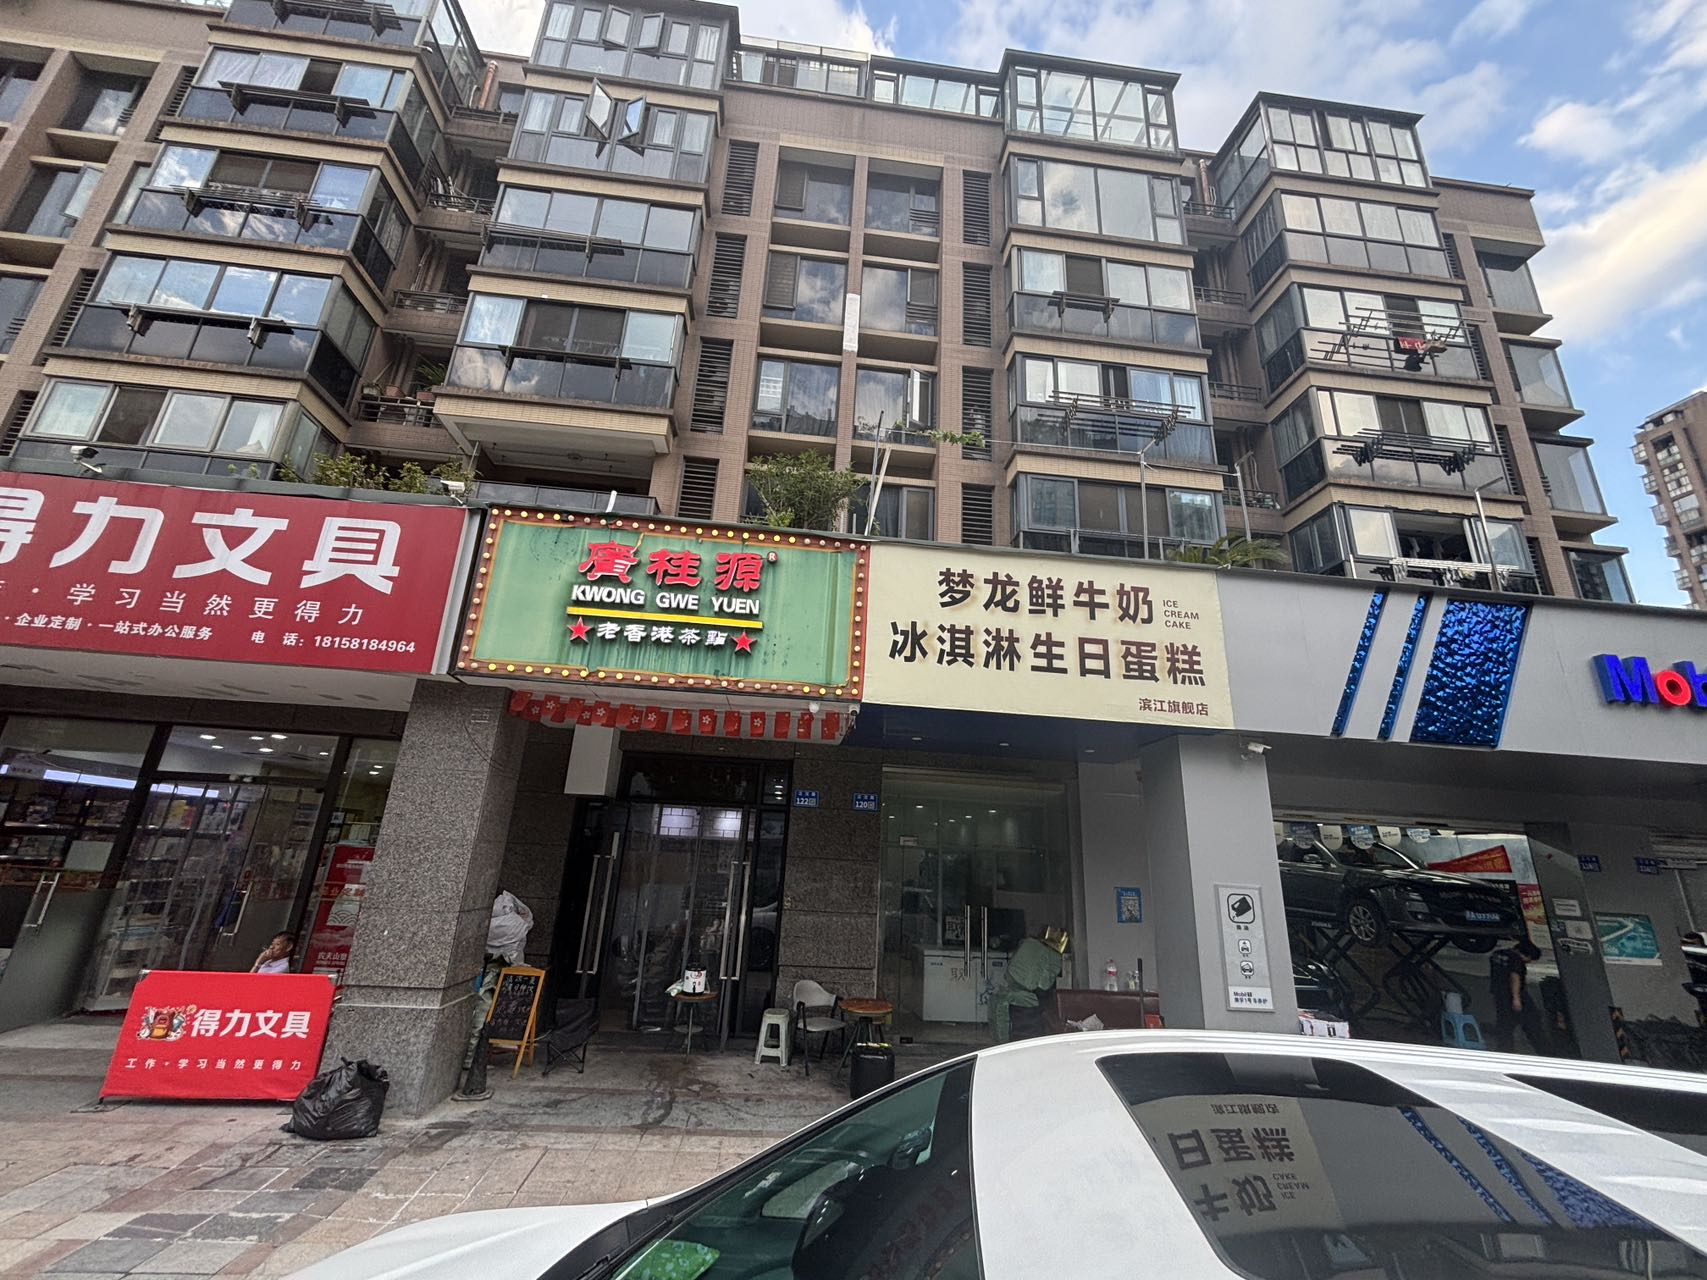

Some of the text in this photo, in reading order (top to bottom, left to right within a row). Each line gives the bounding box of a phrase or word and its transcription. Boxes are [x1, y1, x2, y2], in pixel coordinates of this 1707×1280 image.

[571, 584, 760, 615] KWONG GWE YUEN
[938, 567, 1154, 626] 梦龙鲜牛奶
[1162, 599, 1179, 609] ICE
[1163, 609, 1200, 621] CREAM
[1164, 620, 1191, 630] CAKE
[314, 635, 416, 653] 18158184964
[887, 620, 1207, 687] 冰淇淋生日蛋糕
[1138, 697, 1209, 717] 滨江旗舰店
[796, 797, 808, 805] 122
[855, 801, 868, 809] 120
[191, 1009, 311, 1039] 得力文具
